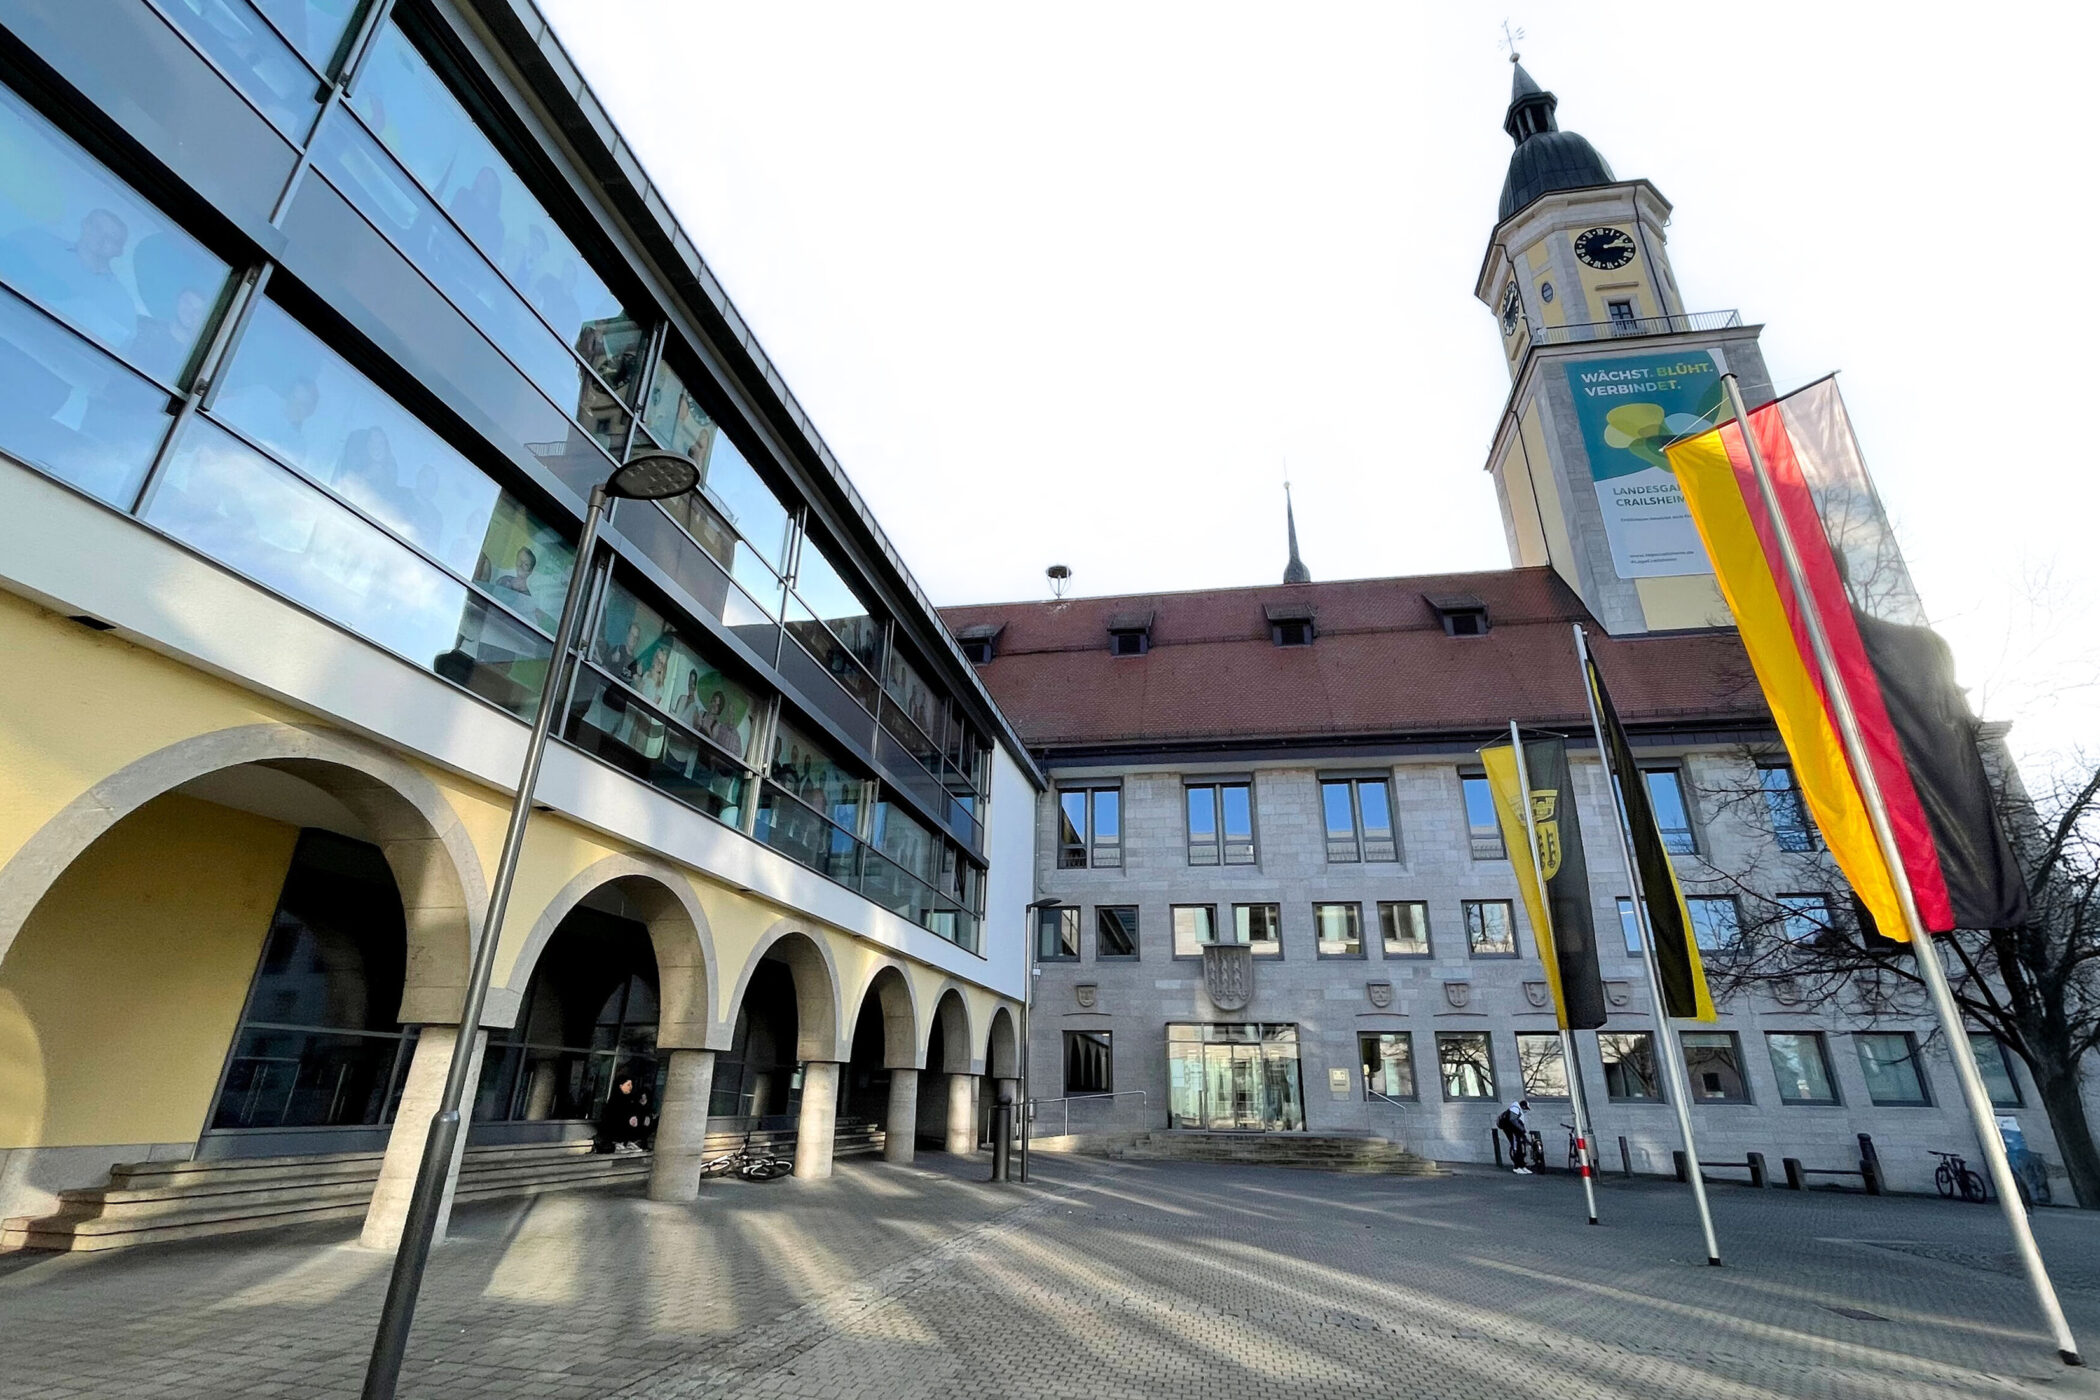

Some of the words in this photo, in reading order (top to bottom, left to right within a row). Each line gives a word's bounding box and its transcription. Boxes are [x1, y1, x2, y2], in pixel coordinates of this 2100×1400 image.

[1581, 368, 1654, 383] WÄCHST.
[1656, 362, 1714, 377] BLÜHT.
[1584, 380, 1682, 397] VERBINDET.
